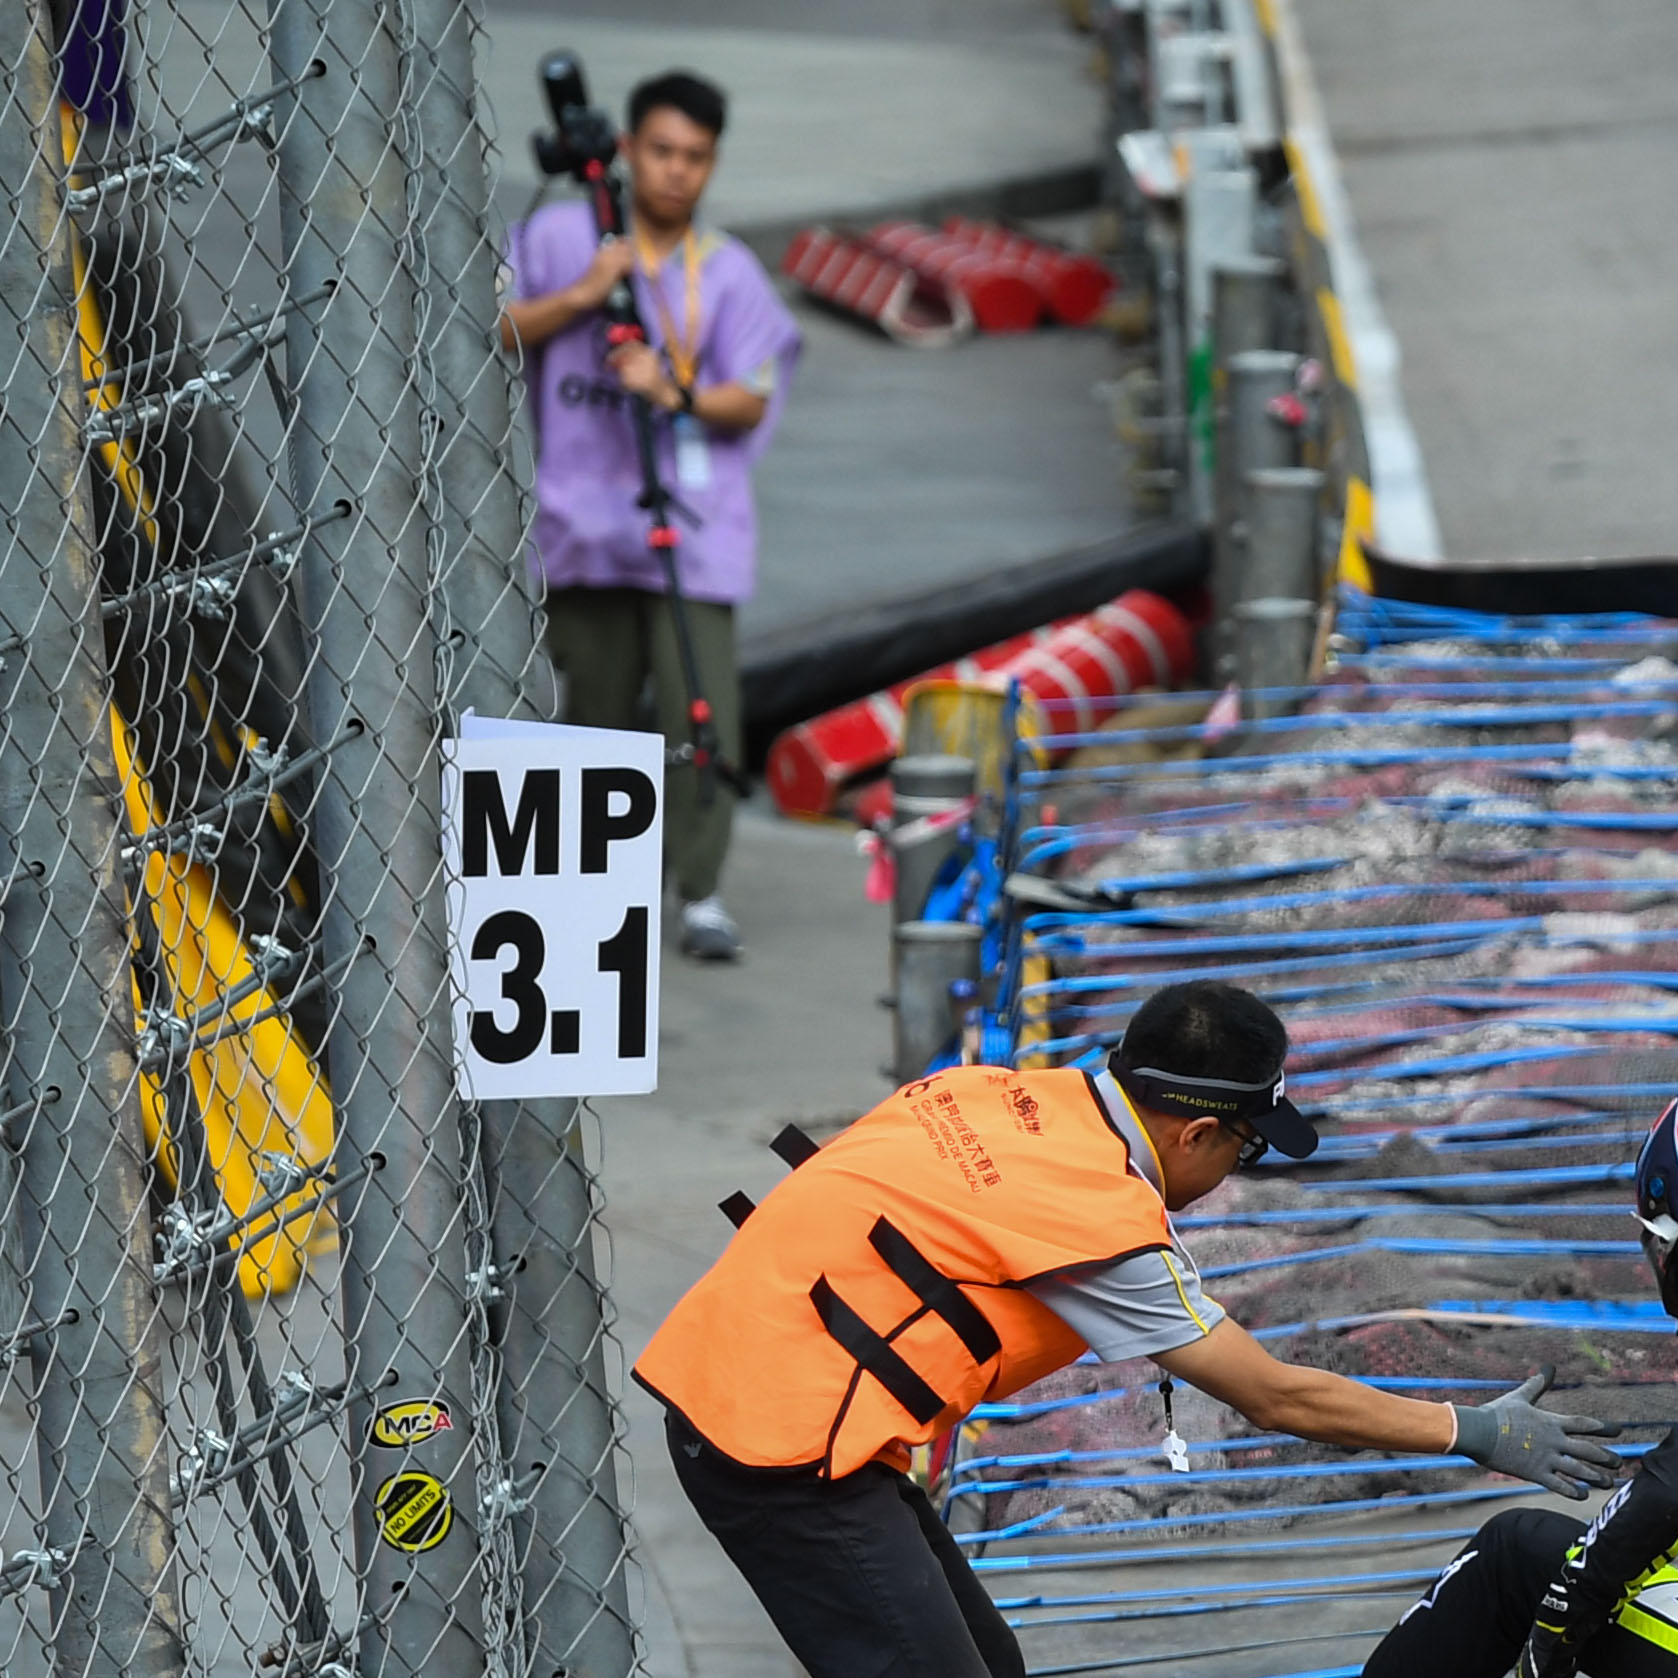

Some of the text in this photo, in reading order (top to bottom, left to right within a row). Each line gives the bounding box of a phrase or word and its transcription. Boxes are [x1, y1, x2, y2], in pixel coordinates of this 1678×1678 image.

[460, 766, 658, 879] MP
[466, 905, 650, 1066] 3.1
[389, 1517, 406, 1534] NO
[405, 1487, 437, 1519] LIMITS
